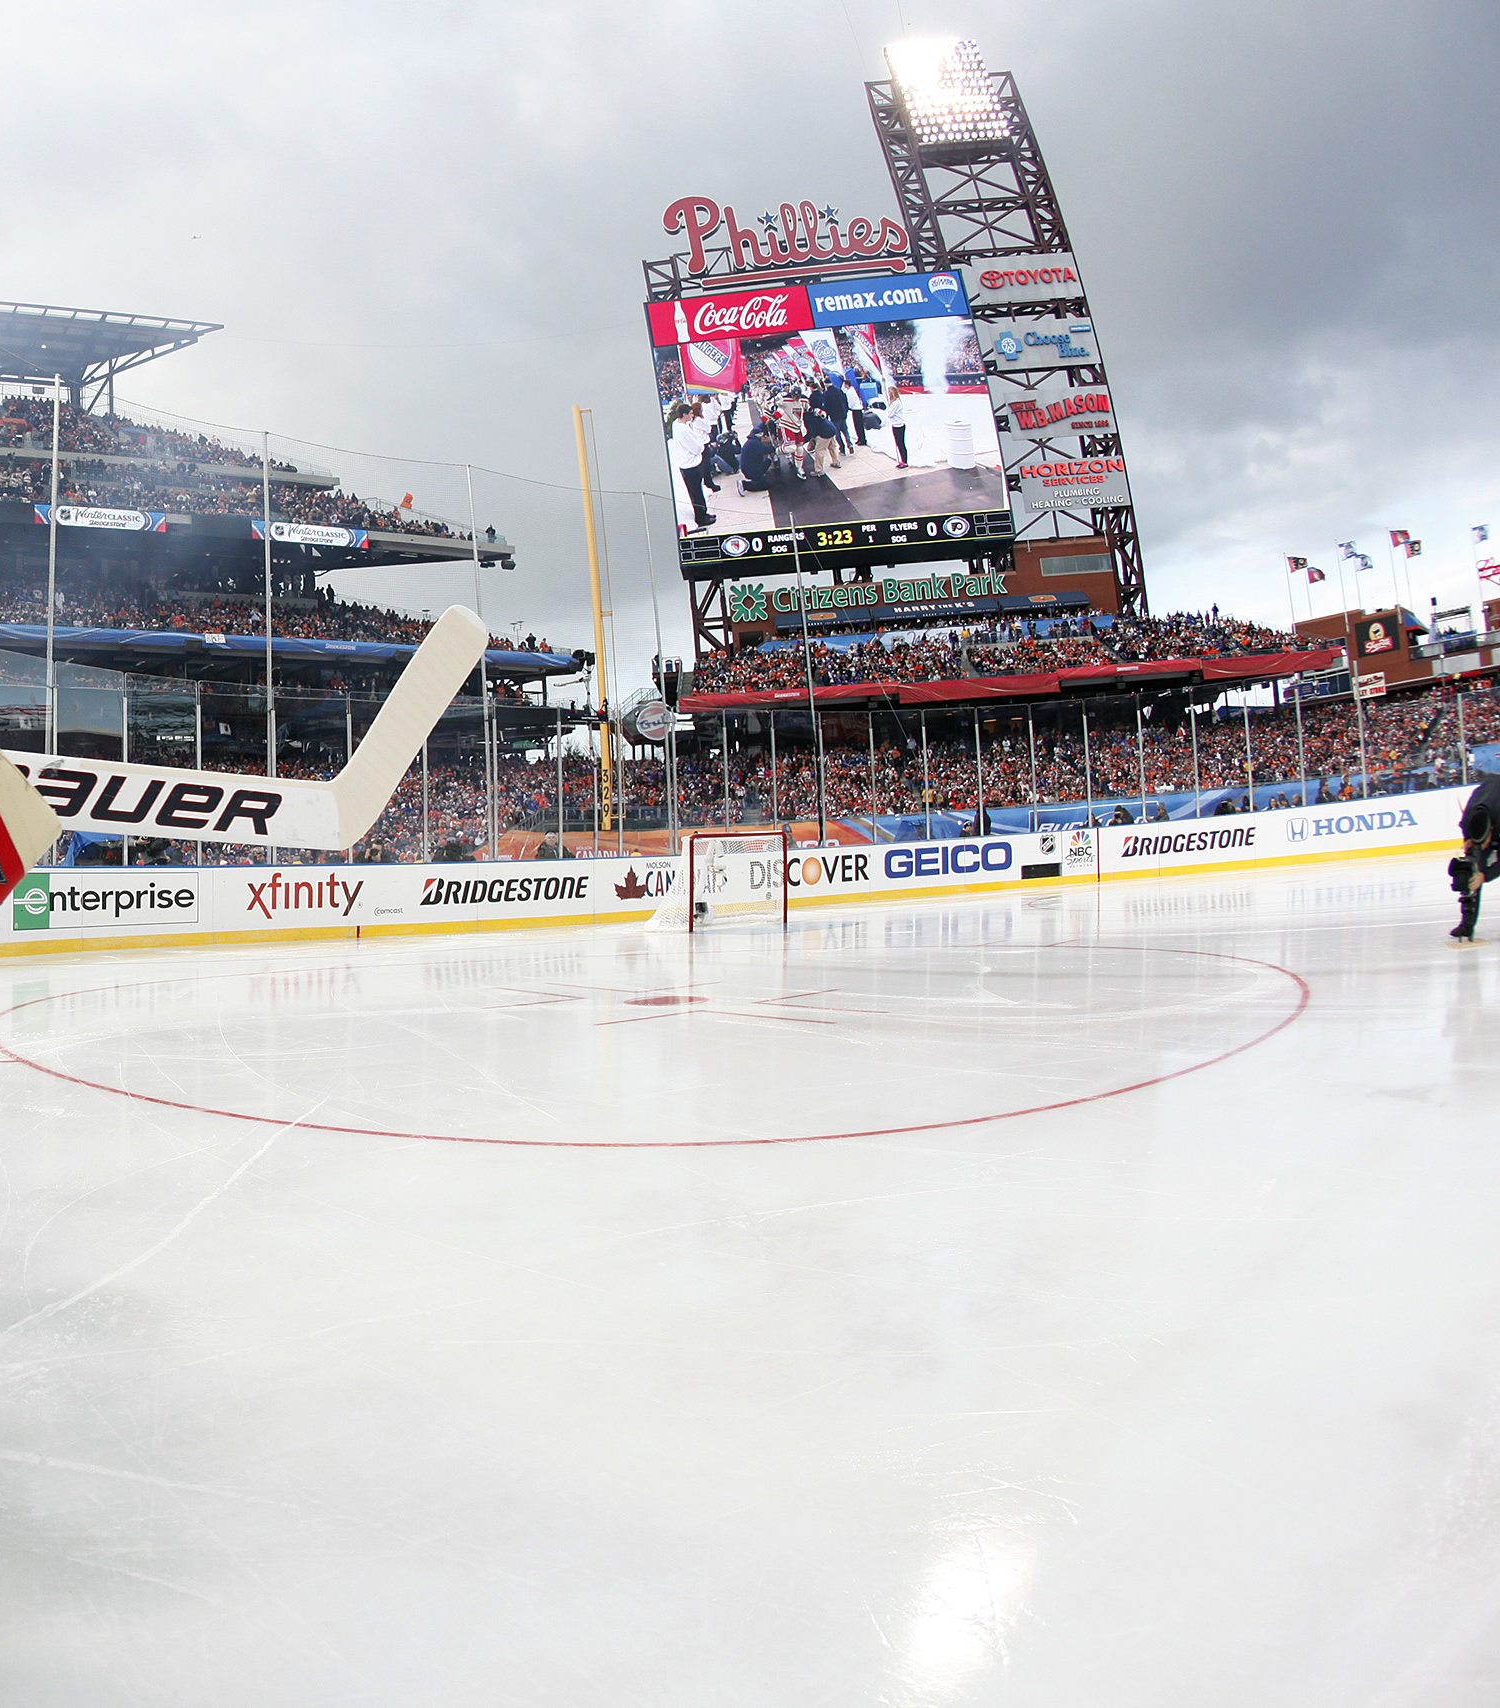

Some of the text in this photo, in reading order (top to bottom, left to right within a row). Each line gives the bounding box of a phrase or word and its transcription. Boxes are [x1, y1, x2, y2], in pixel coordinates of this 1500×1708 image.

[662, 196, 909, 275] Phillies
[1004, 267, 1077, 286] TOYOTA
[814, 286, 924, 313] remax.com
[694, 293, 789, 335] Coca-Cola
[1024, 331, 1071, 347] Choose
[693, 341, 725, 364] ANGERS
[1057, 344, 1090, 359] Blue.
[1020, 458, 1125, 479] HORIZON
[1043, 475, 1106, 487] SERVICES
[1054, 487, 1100, 498] PLUMBING
[1032, 494, 1124, 509] HEATING COOLING
[108, 514, 141, 523] CLASSIC
[889, 522, 918, 531] FLYERS
[861, 524, 877, 532] PER
[926, 521, 938, 536] 0
[751, 537, 763, 552] 0
[817, 530, 853, 547] 3:23
[891, 535, 907, 543] SOG
[771, 545, 788, 554] SOG
[771, 567, 1008, 614] Citizens Bank Park
[894, 603, 937, 613] HARRY
[14, 764, 283, 836] AUER
[1312, 809, 1418, 837] HONDA
[1122, 827, 1255, 857] BRIDGESTONE
[1069, 846, 1093, 857] NBC
[646, 861, 671, 869] MOLSON
[884, 841, 1013, 879] GEICO
[246, 872, 364, 919] xfinity
[420, 876, 589, 906] BRIDGESTONE
[13, 882, 195, 918] enterprise
[373, 905, 403, 917] comcast
